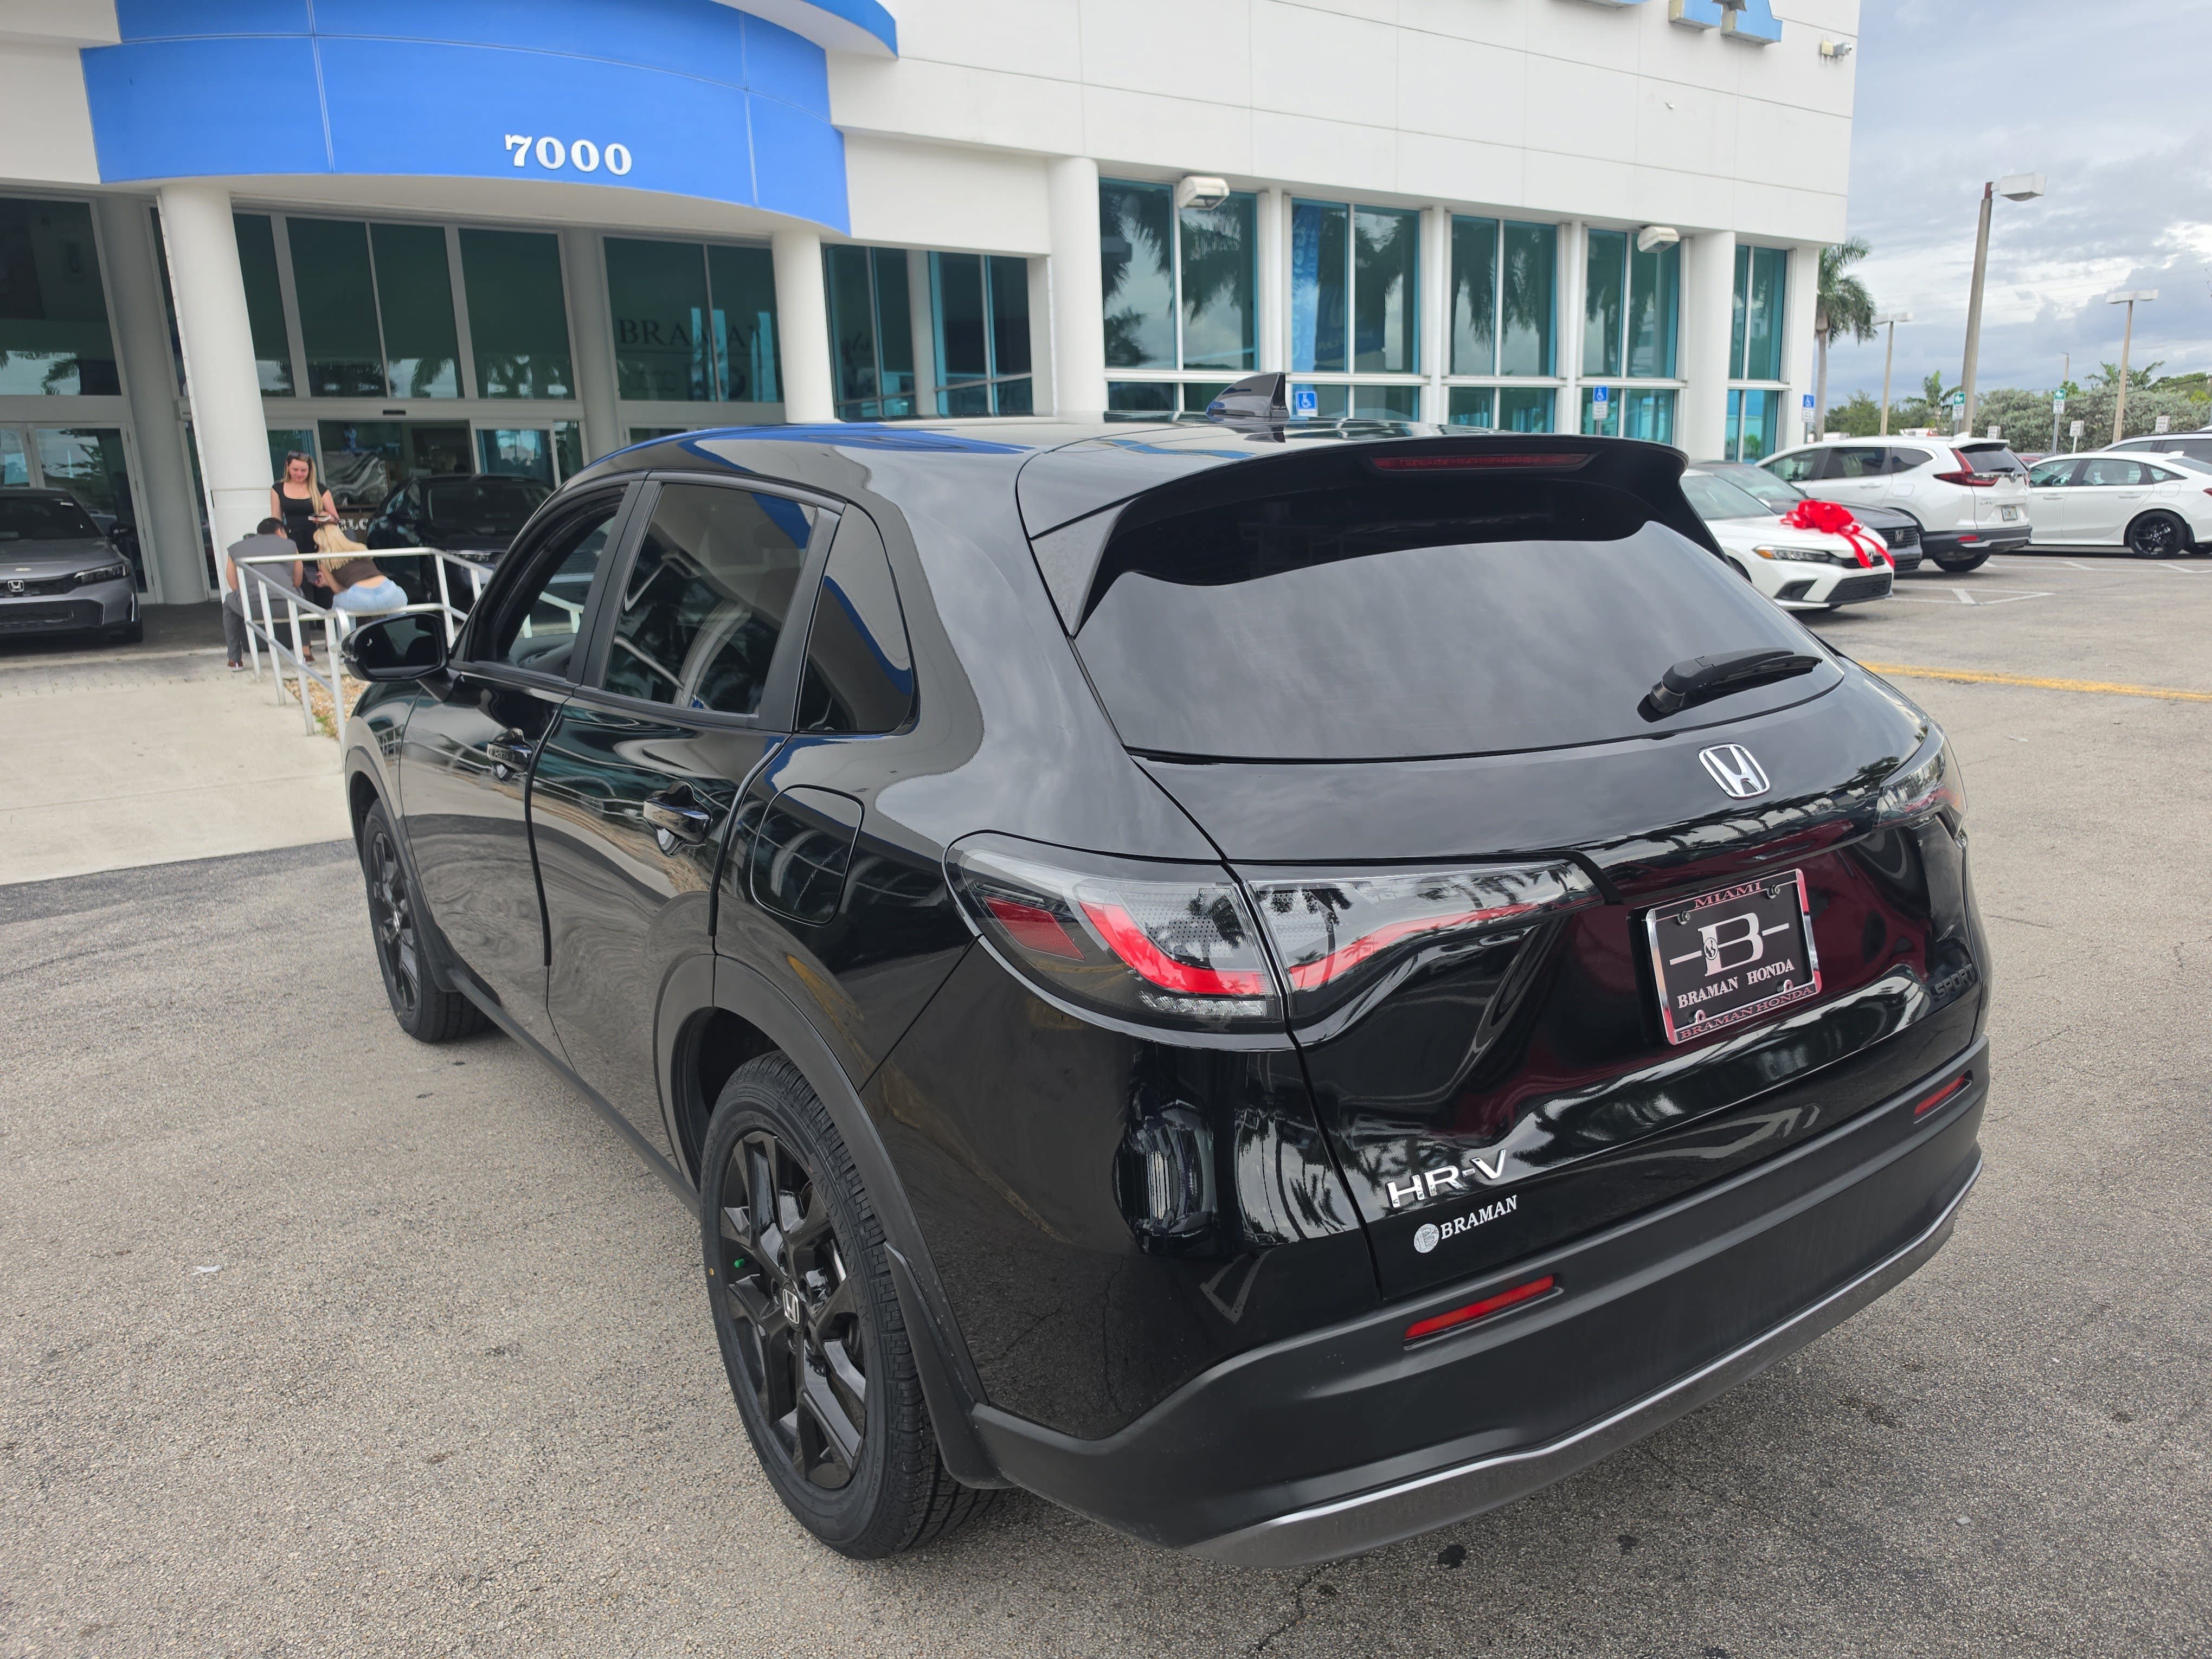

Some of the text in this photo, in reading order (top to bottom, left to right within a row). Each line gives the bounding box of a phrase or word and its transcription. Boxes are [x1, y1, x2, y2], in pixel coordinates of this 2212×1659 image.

[504, 134, 633, 176] 7000
[618, 319, 761, 348] BRAA
[1694, 881, 1762, 909] MIAMI
[1697, 912, 1763, 977] B
[1677, 959, 1795, 1008] BRAMAN HONDA
[1680, 986, 1814, 1039] BRAMAN HONDA
[1386, 1149, 1506, 1208] HR-V
[1441, 1194, 1517, 1240] BRAMAN
